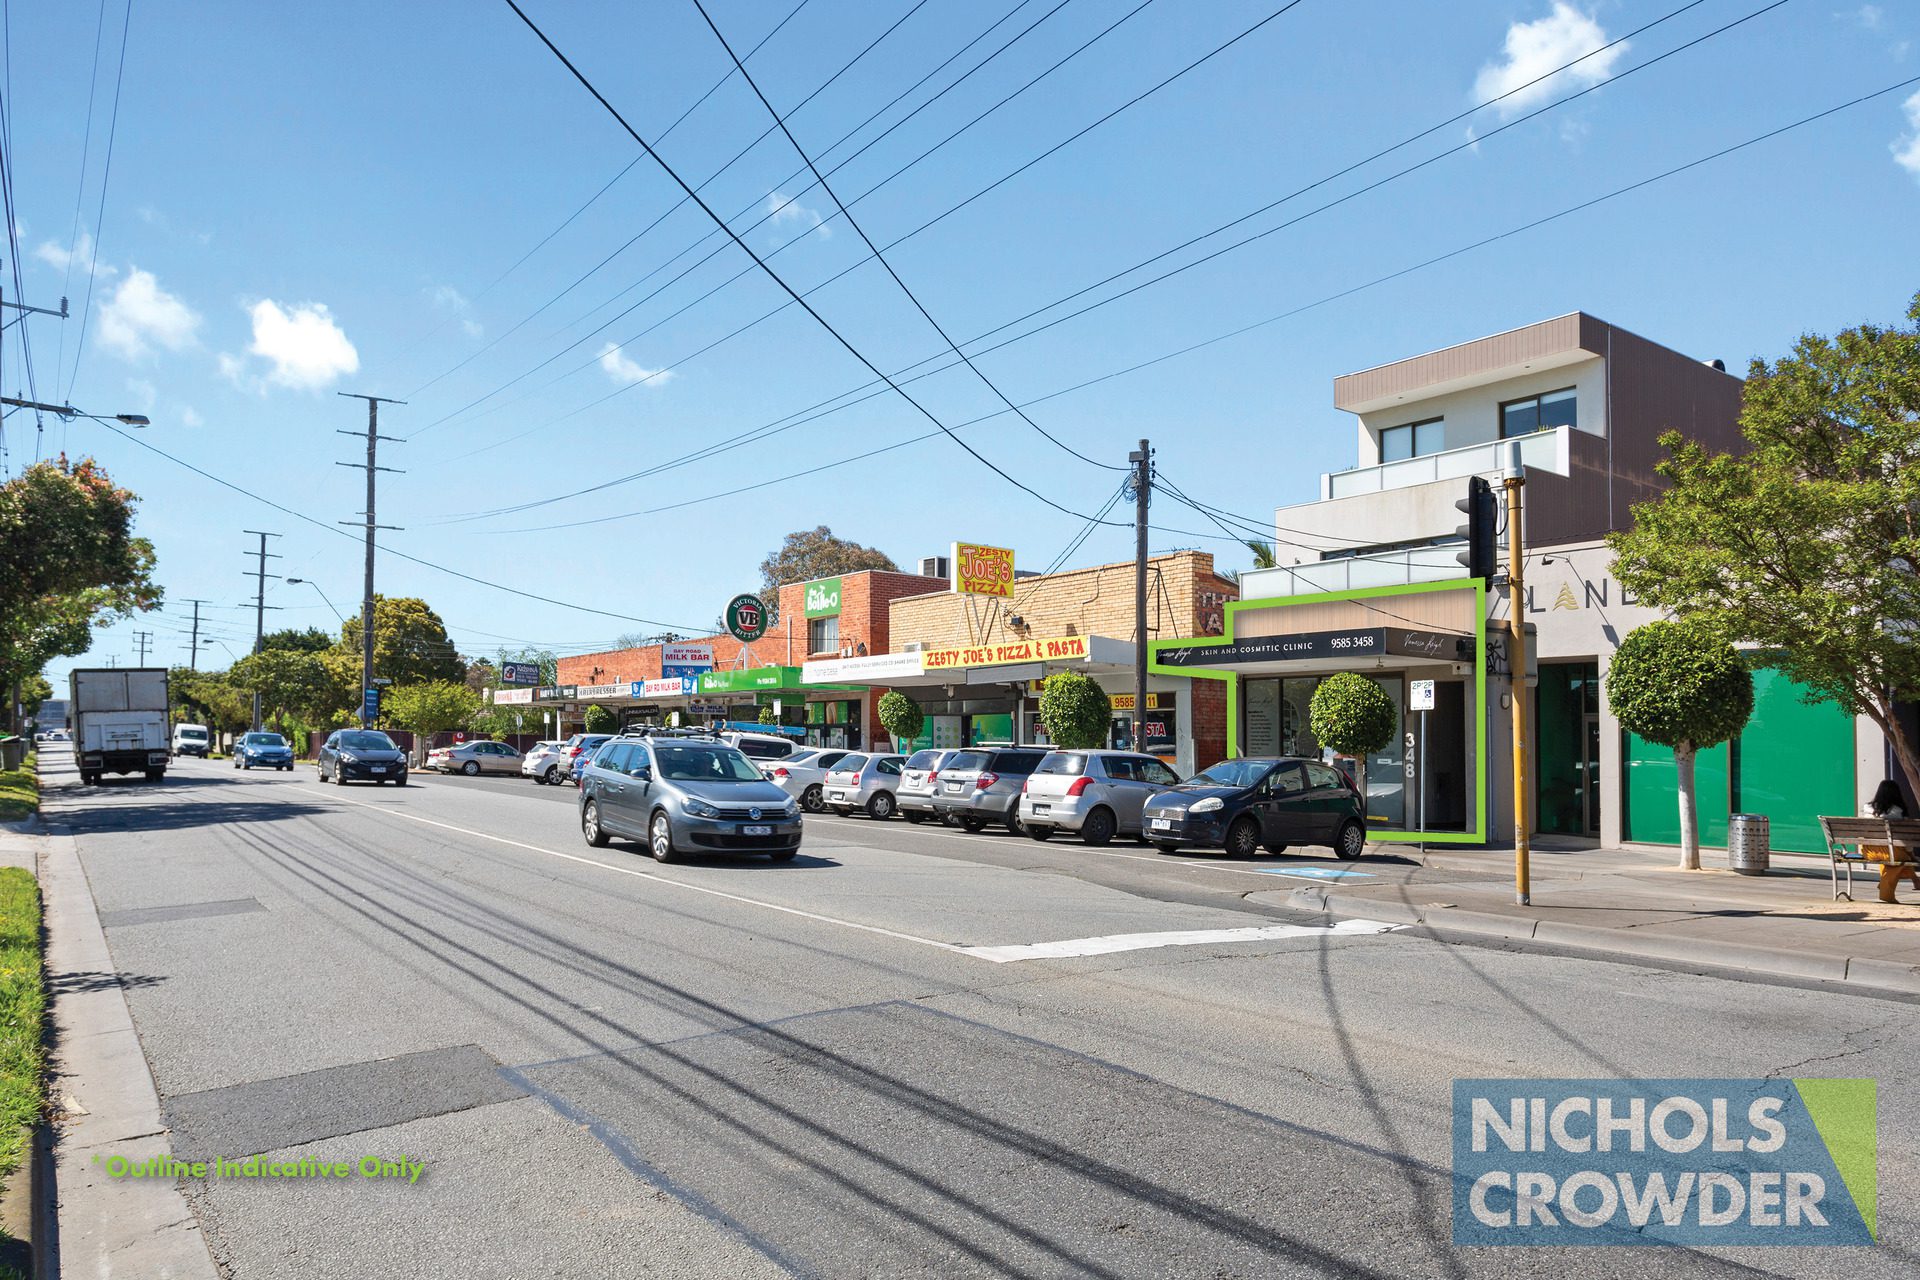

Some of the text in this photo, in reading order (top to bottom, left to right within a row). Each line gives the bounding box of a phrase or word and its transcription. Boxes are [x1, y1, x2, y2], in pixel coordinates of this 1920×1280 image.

[979, 547, 1011, 559] ZESTY
[959, 545, 1012, 584] JOE'S
[963, 580, 1007, 596] PIZZA
[733, 599, 763, 611] VICTORIA
[739, 611, 759, 625] VB
[735, 627, 761, 638] BITTER
[1239, 645, 1280, 653] COSMETIC
[1283, 642, 1313, 651] CLINIC
[1331, 636, 1374, 649] 9585 3458
[926, 651, 959, 666] ZESTY
[963, 647, 993, 664] JOE'S
[997, 644, 1032, 660] PIZZA
[1047, 639, 1085, 656] PASTA
[660, 682, 671, 691] MILK
[671, 681, 681, 690] BAR
[1114, 697, 1135, 708] 9585
